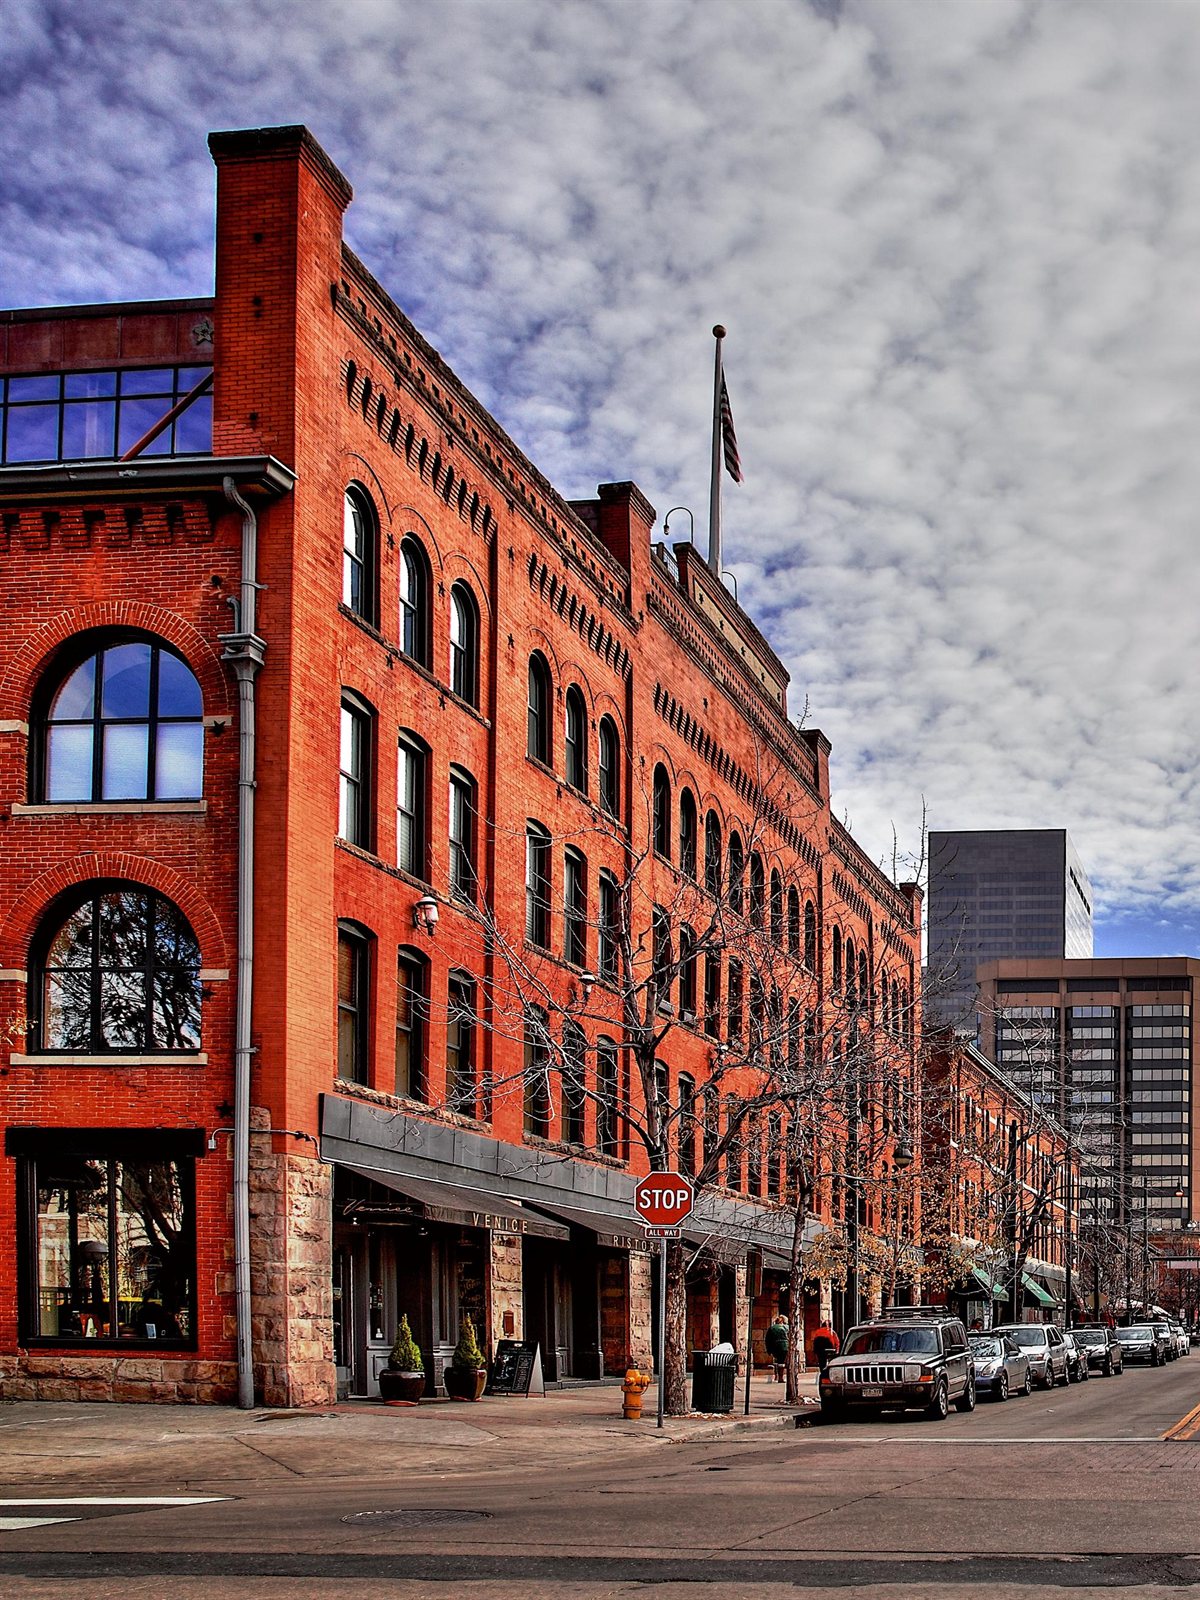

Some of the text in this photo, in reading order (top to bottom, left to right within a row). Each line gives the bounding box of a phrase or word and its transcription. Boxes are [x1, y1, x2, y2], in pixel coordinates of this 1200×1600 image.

[342, 1199, 414, 1216] Venice
[639, 1189, 689, 1209] STOP
[472, 1212, 528, 1234] VENICE
